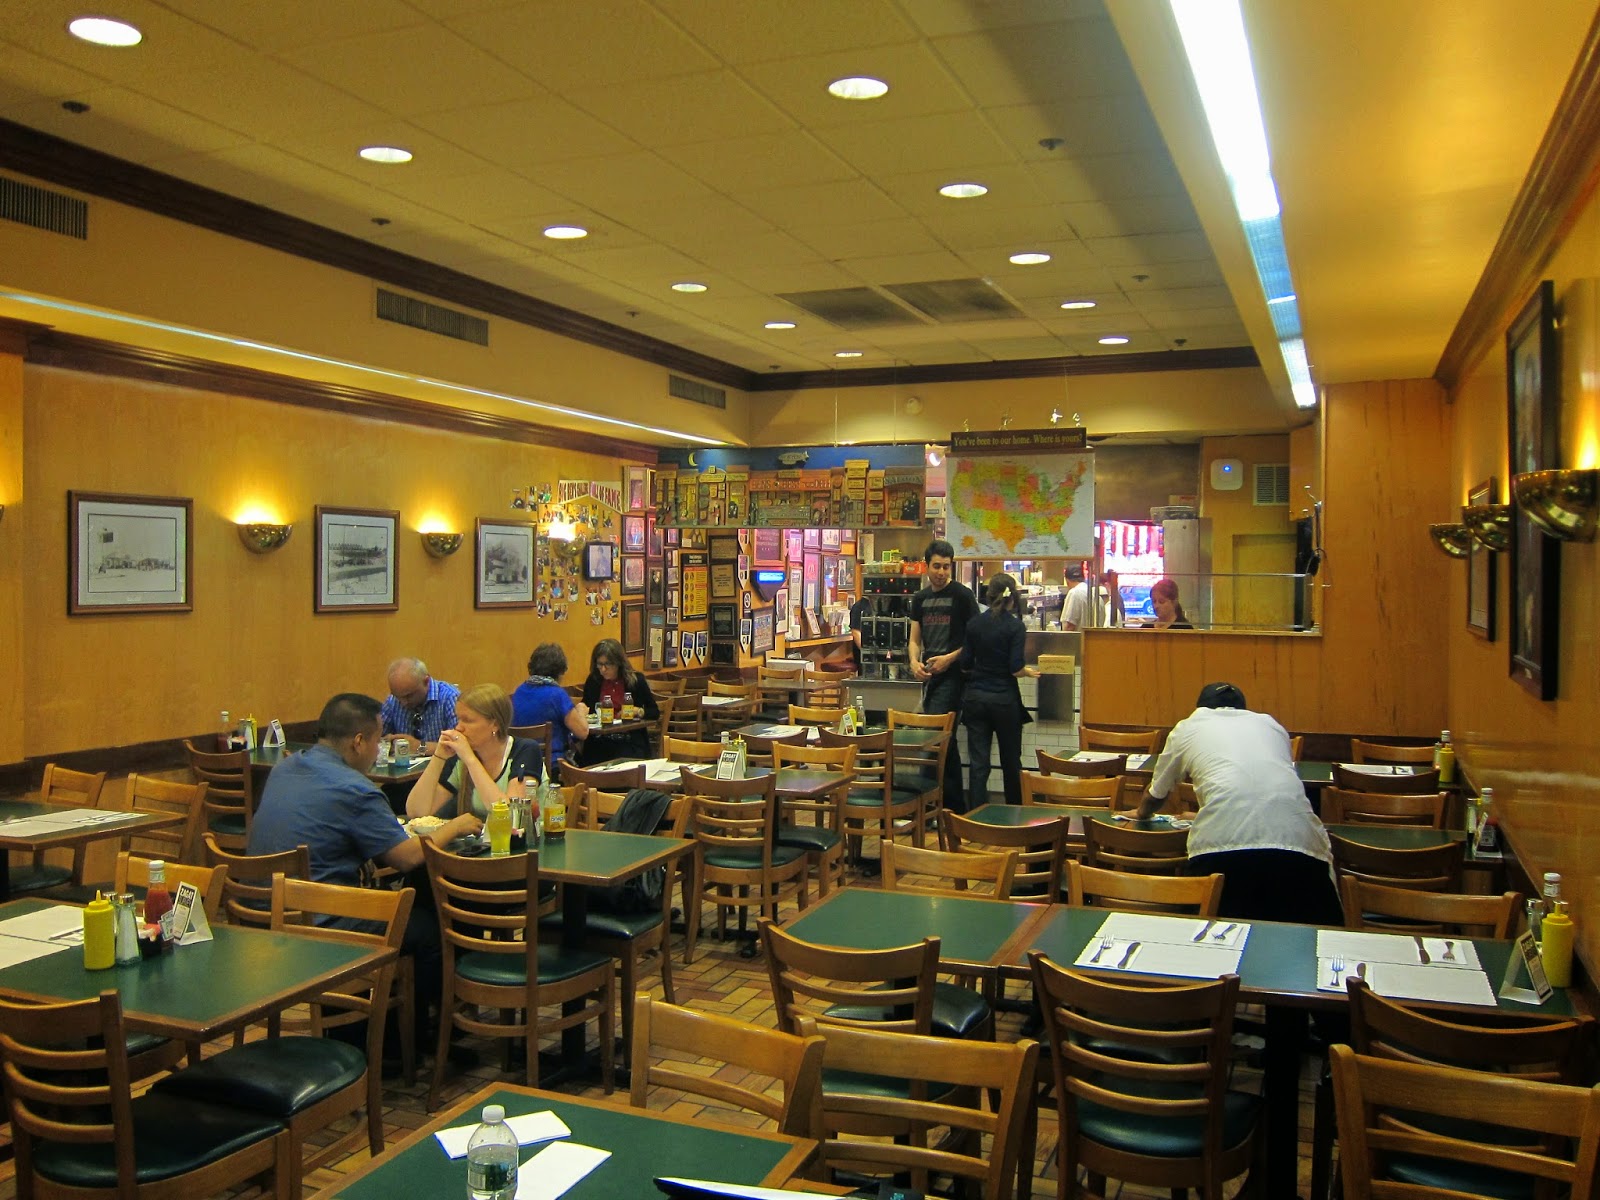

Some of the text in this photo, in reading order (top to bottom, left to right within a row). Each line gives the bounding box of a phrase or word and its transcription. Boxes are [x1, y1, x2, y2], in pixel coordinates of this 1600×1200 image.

[954, 436, 975, 447] You've
[976, 436, 991, 446] been
[992, 436, 999, 445] to
[1000, 437, 1011, 445] our
[1033, 434, 1054, 444] Where
[1055, 434, 1061, 443] is
[1061, 433, 1083, 445] yours?
[179, 887, 194, 900] ZAGAT
